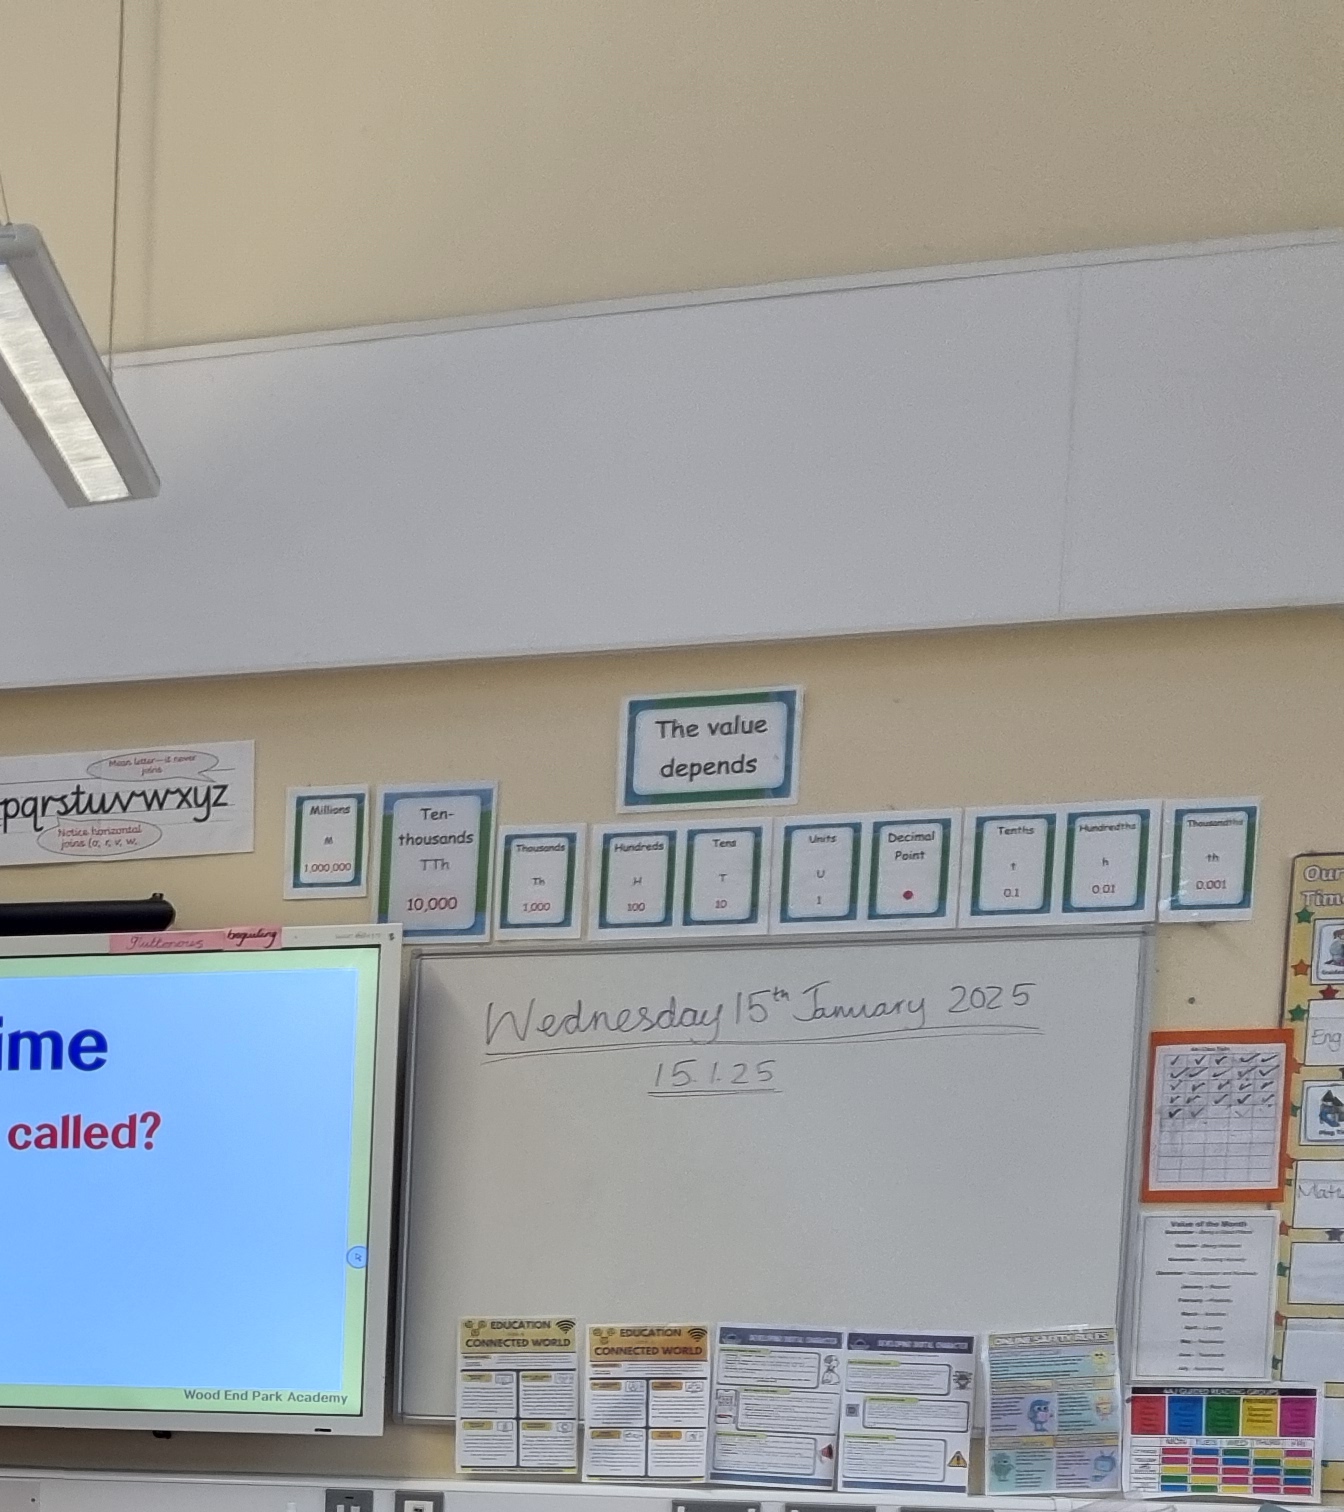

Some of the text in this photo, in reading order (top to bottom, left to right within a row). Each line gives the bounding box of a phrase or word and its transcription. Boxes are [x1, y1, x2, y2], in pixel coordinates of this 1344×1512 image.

[656, 716, 768, 739] The value
[141, 766, 163, 776] joins
[659, 755, 758, 779] depends
[310, 804, 351, 816] Millions
[420, 807, 455, 821] Ten-
[57, 824, 142, 837] Notice horizontal
[997, 825, 1035, 837] Tenths
[324, 836, 334, 846] M
[398, 830, 474, 848] thousands
[713, 837, 737, 849] Tens
[809, 833, 837, 845] Units
[888, 830, 936, 844] Decimal
[516, 842, 566, 854] Thousands
[614, 840, 665, 853] Hundreds
[895, 849, 926, 862] Point
[304, 862, 352, 874] 1,000,000
[420, 857, 450, 872] TTh
[719, 873, 727, 883] T
[817, 869, 825, 879] U
[533, 877, 545, 887] Th
[633, 877, 642, 887] H
[1196, 879, 1227, 891] 0.001
[1003, 887, 1020, 899] 0.1
[1092, 883, 1116, 895] 0.01
[406, 896, 457, 912] 10,000
[522, 901, 551, 913] 1,000
[627, 902, 646, 913] 100
[715, 899, 728, 910] 10
[485, 996, 725, 1046] Wednesday
[793, 981, 925, 1030] January
[949, 983, 1038, 1014] 2025
[7, 1112, 162, 1151] called?
[491, 1320, 551, 1330] EDUCATION
[619, 1327, 682, 1338] EDUCATION
[466, 1338, 571, 1348] CONNECTED WORLD
[594, 1346, 703, 1356] CONNECTED WORLD
[183, 1389, 349, 1405] Wood End Park Academy
